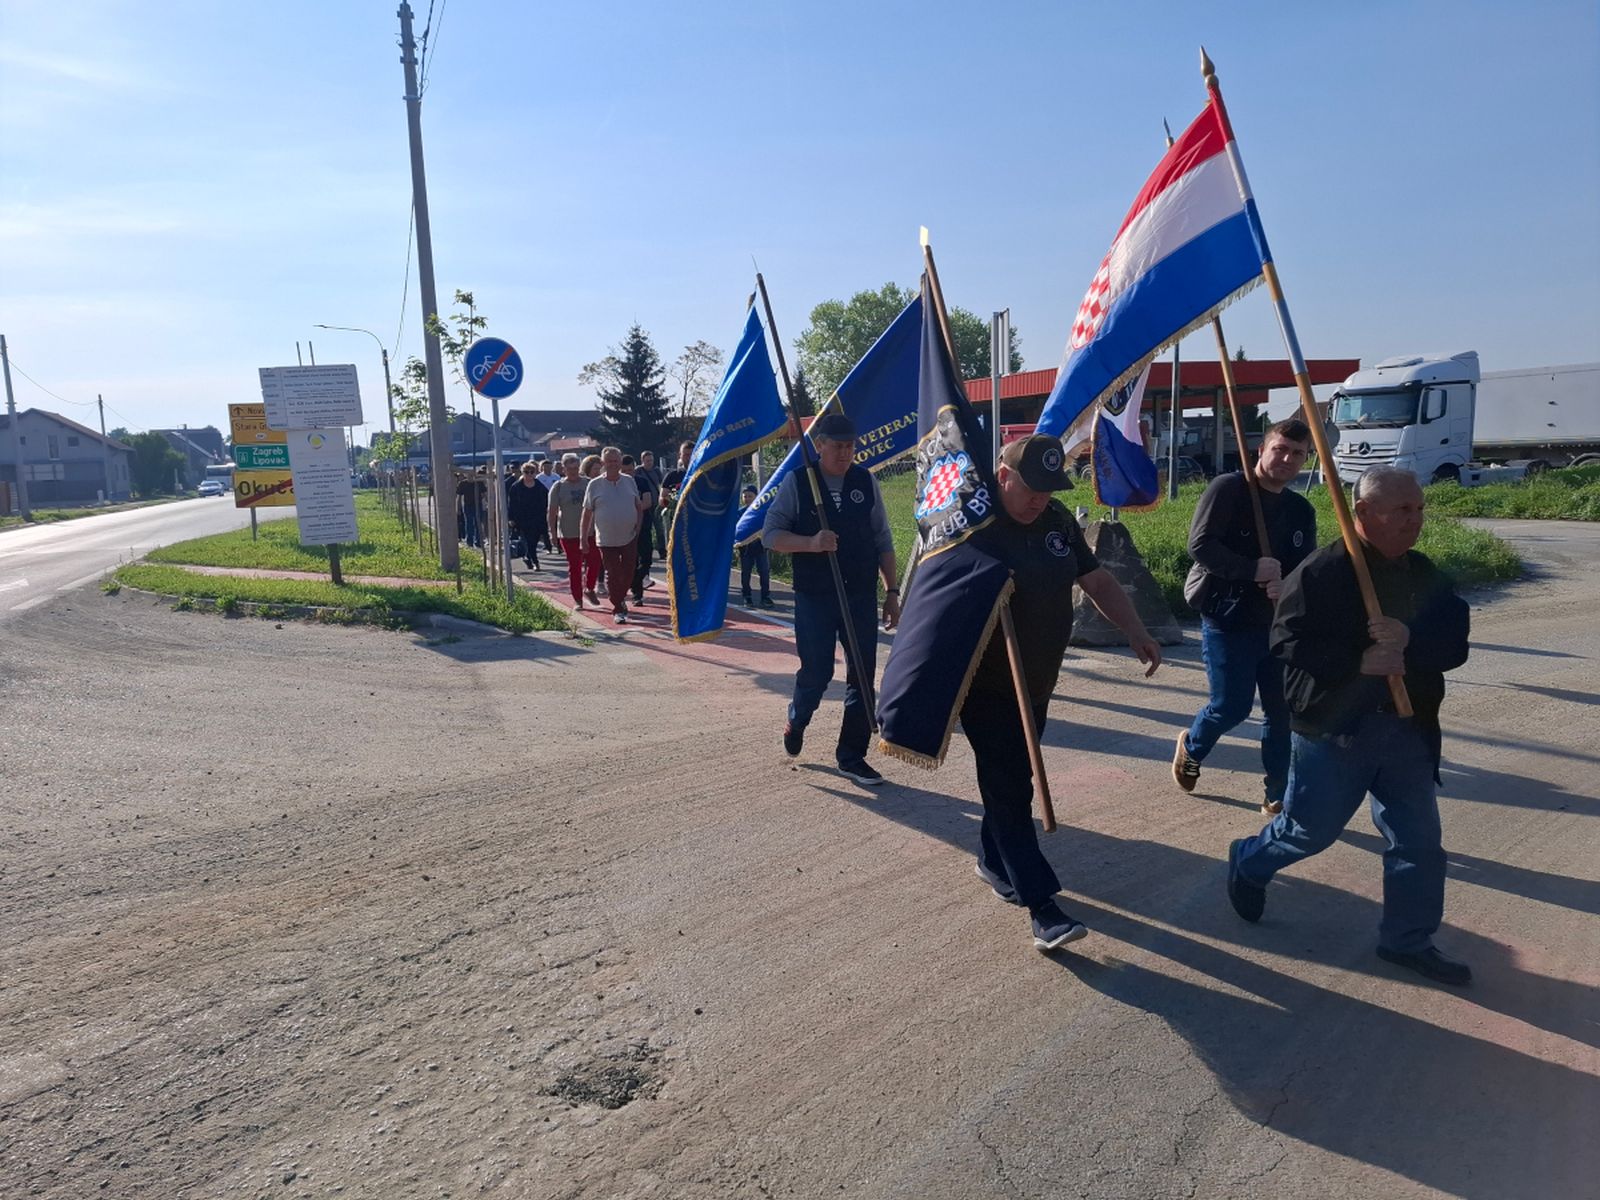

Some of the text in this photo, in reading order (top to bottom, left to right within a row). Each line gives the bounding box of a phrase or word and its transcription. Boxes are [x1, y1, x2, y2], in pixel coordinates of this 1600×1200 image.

[234, 422, 257, 432] Stara
[726, 416, 755, 433] RATA
[252, 447, 283, 458] Zagreb
[253, 456, 286, 466] Lipovac
